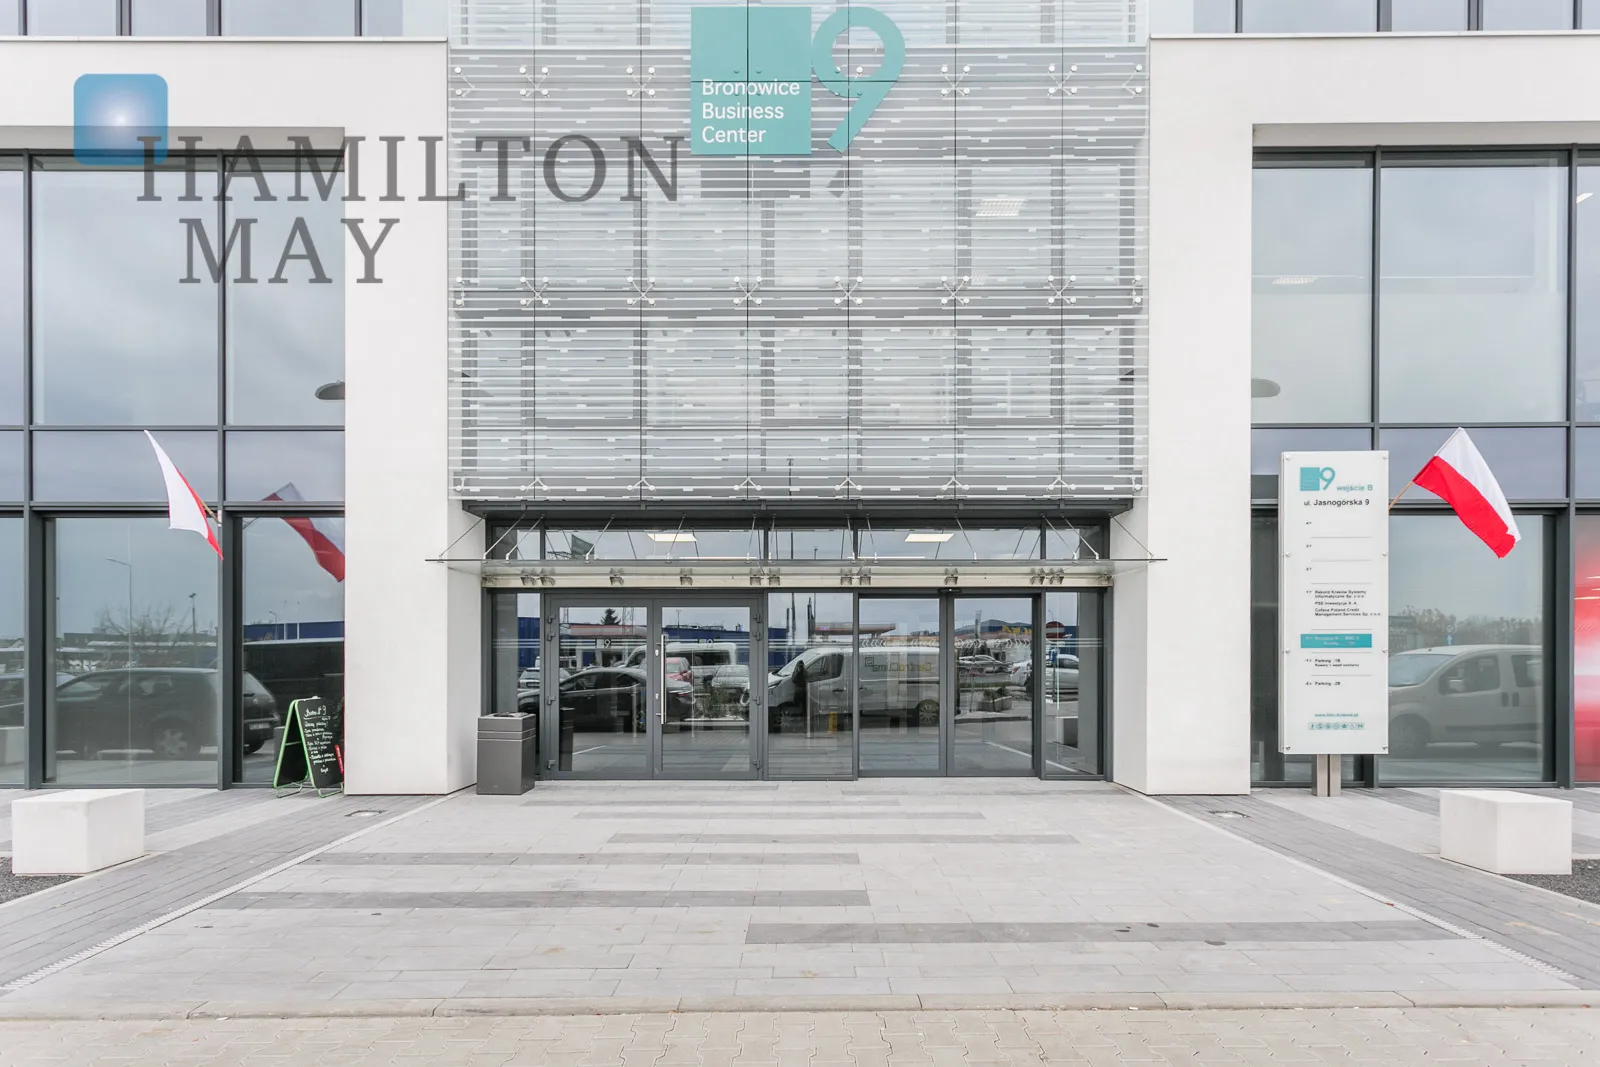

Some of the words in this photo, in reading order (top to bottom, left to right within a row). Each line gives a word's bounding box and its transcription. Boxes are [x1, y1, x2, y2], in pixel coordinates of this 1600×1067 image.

[702, 79, 801, 96] Bronowice
[812, 7, 906, 154] 9
[702, 102, 785, 119] Business
[702, 126, 767, 143] Center
[1320, 466, 1336, 490] 9
[1313, 499, 1363, 507] Jasnogórska
